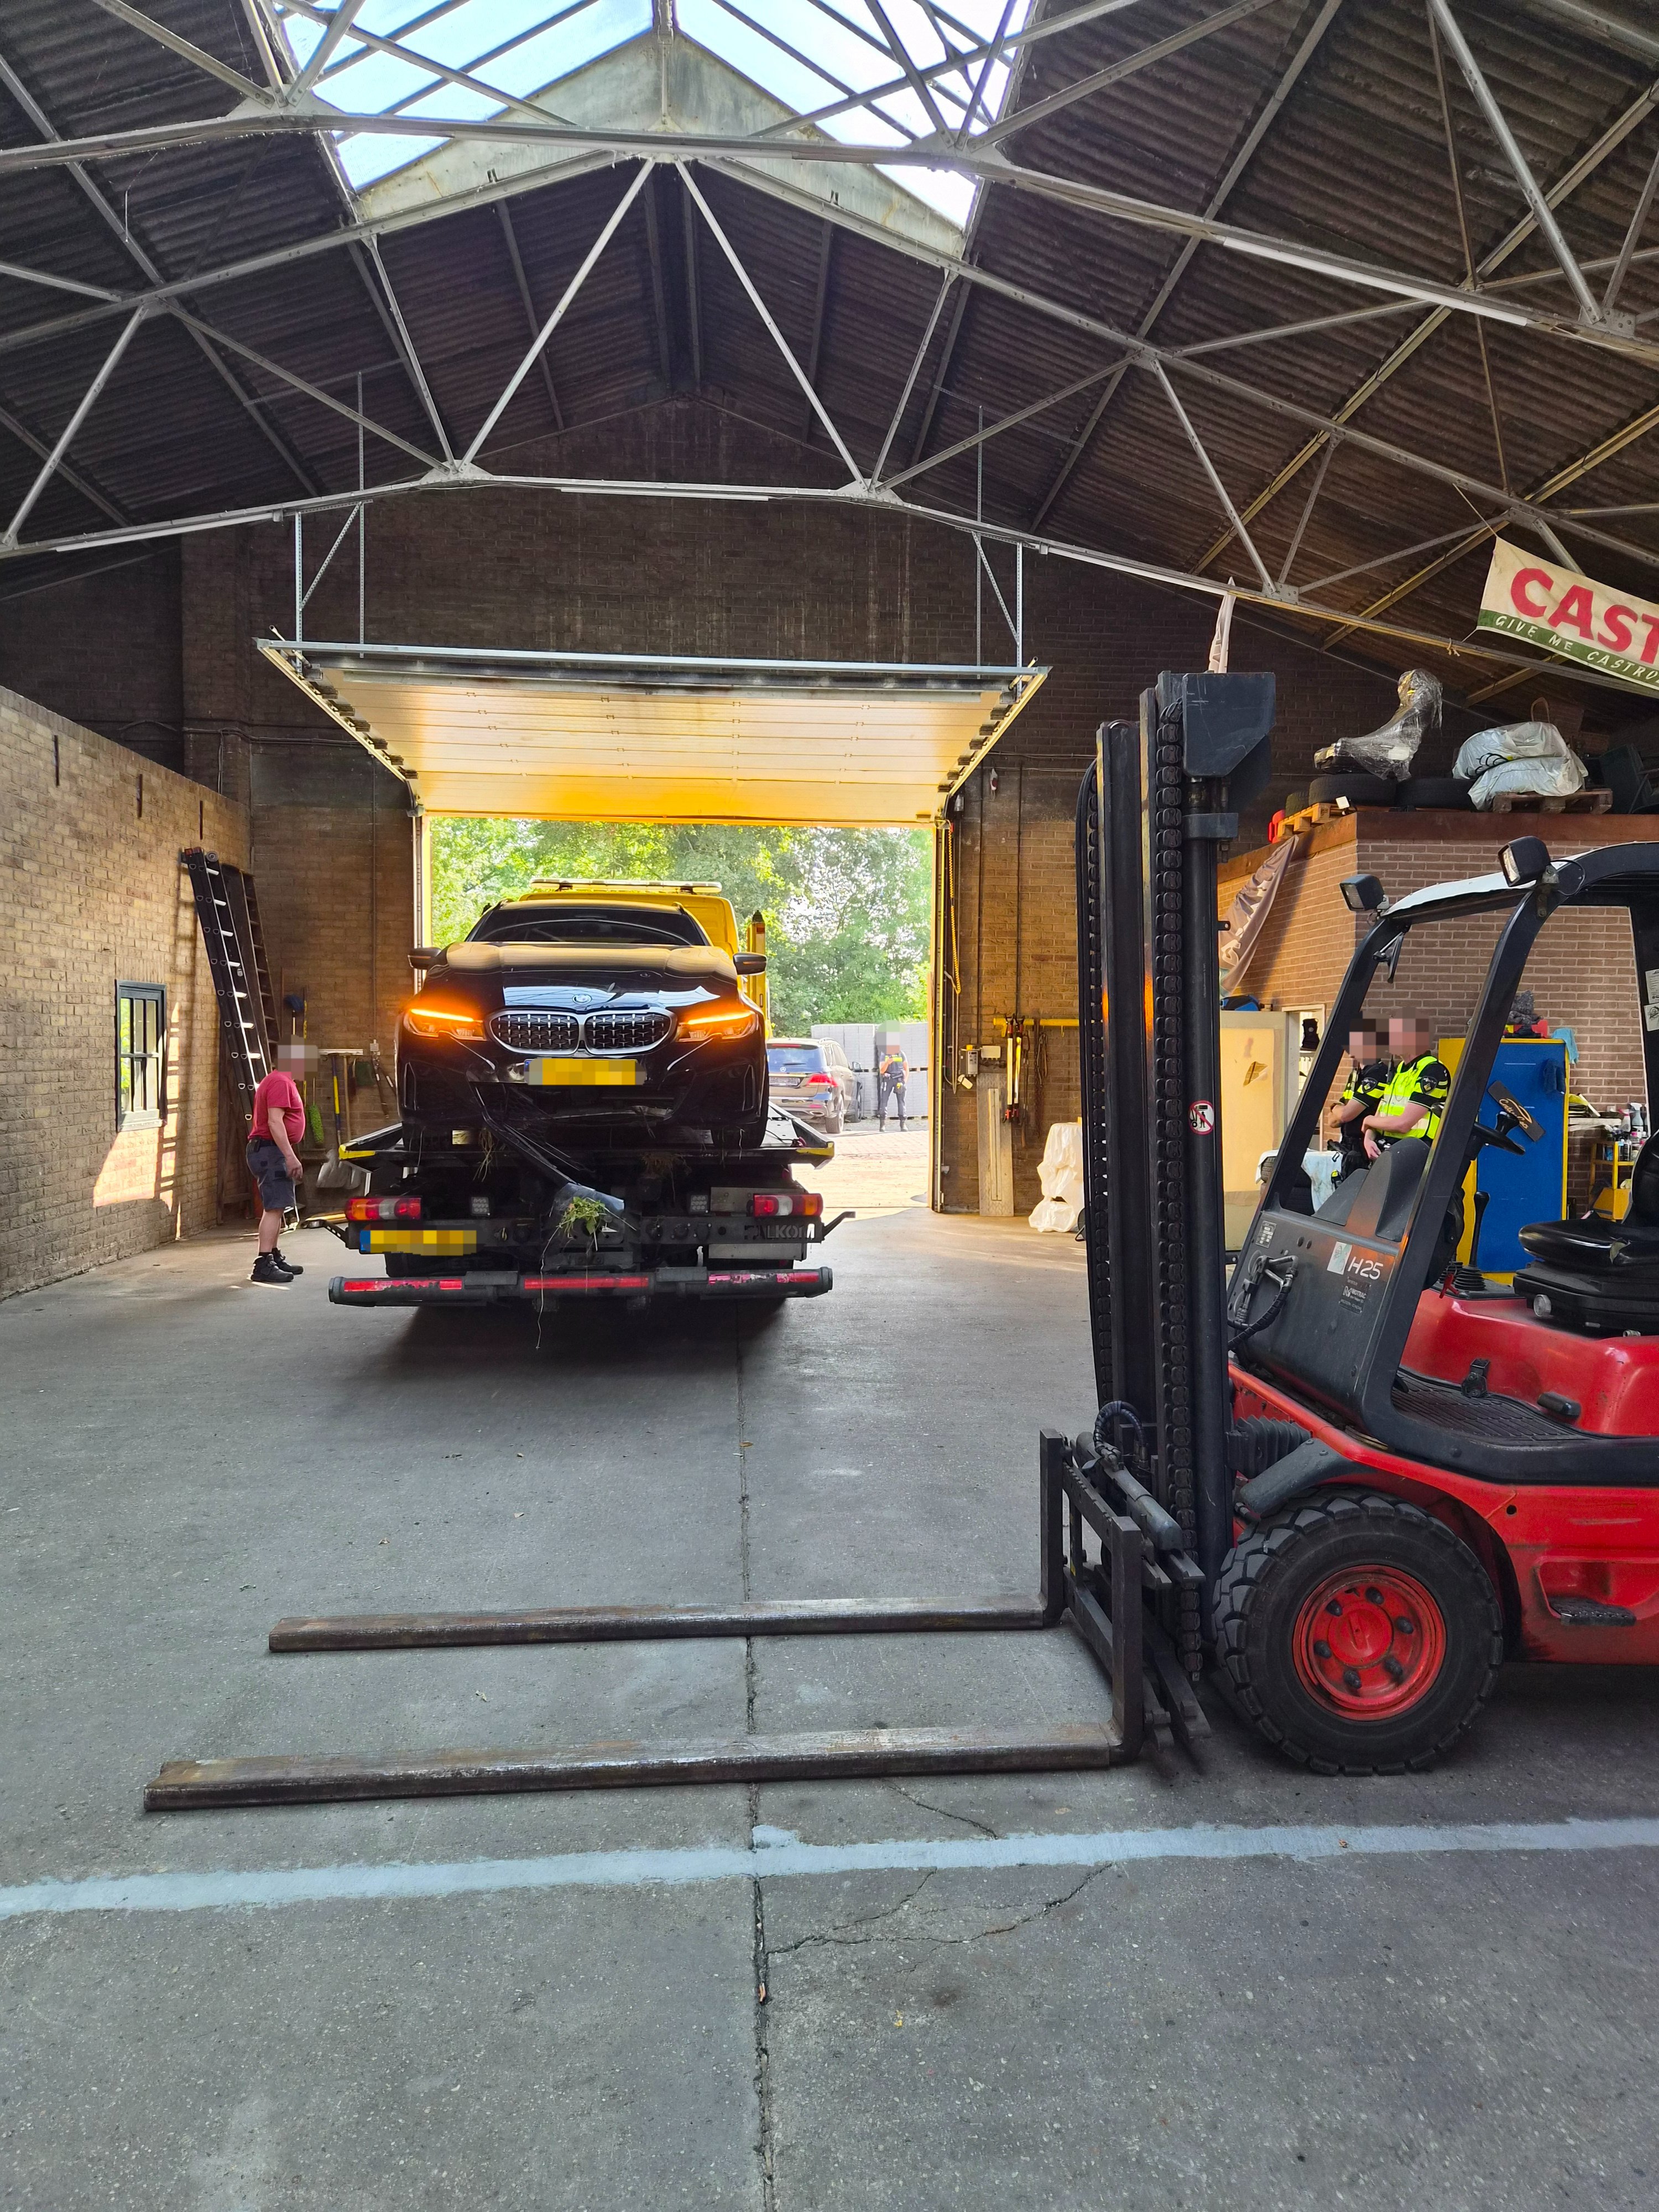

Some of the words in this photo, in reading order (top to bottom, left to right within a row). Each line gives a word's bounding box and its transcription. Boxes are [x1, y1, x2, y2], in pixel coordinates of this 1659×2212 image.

[1495, 615, 1538, 637] GIVE
[1548, 634, 1573, 651] ME
[1587, 651, 1659, 684] CASTRO
[1348, 1256, 1384, 1280] H25
